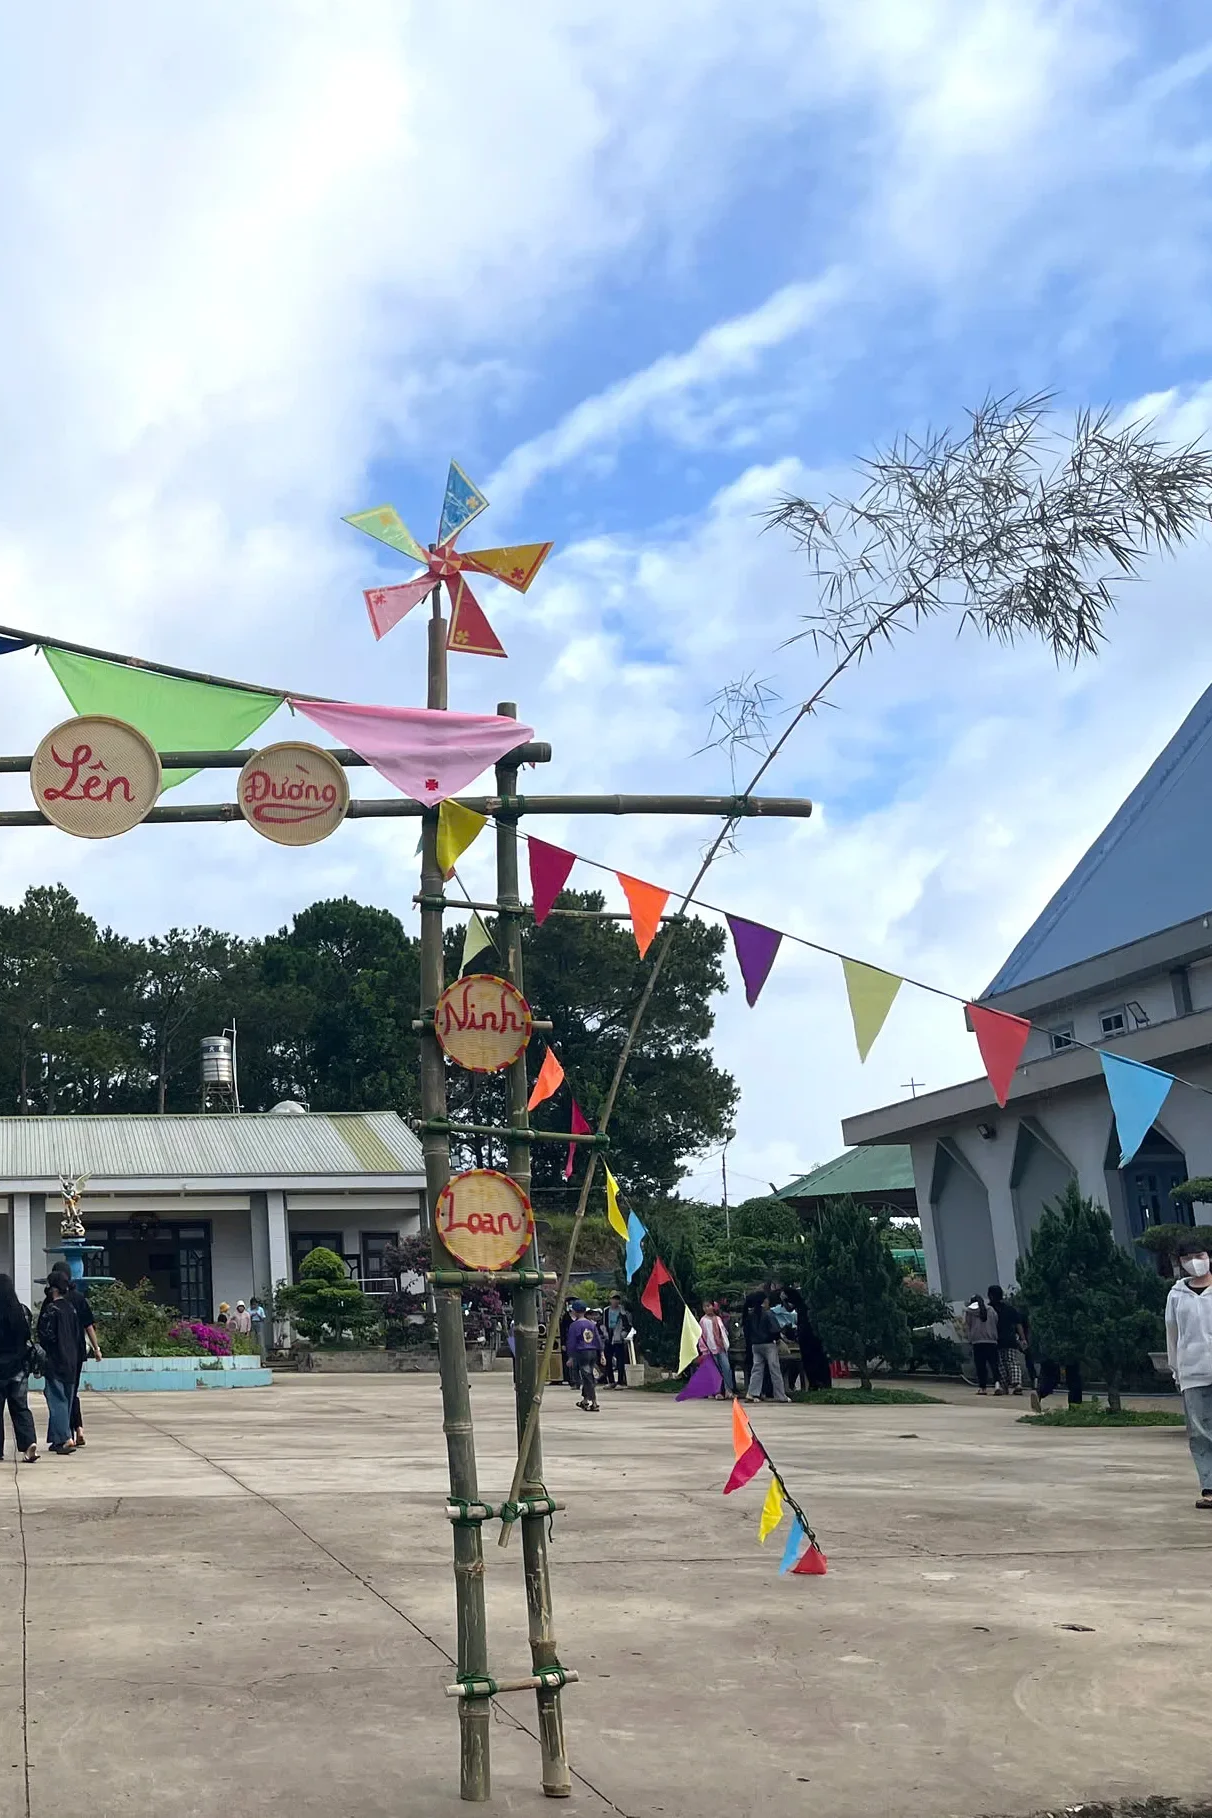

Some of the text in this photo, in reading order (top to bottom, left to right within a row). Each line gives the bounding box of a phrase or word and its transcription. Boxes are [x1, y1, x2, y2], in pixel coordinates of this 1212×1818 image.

[44, 744, 135, 803] Lên
[244, 764, 337, 824] Đường
[443, 984, 522, 1035] Ninh
[443, 1191, 523, 1236] Loan
